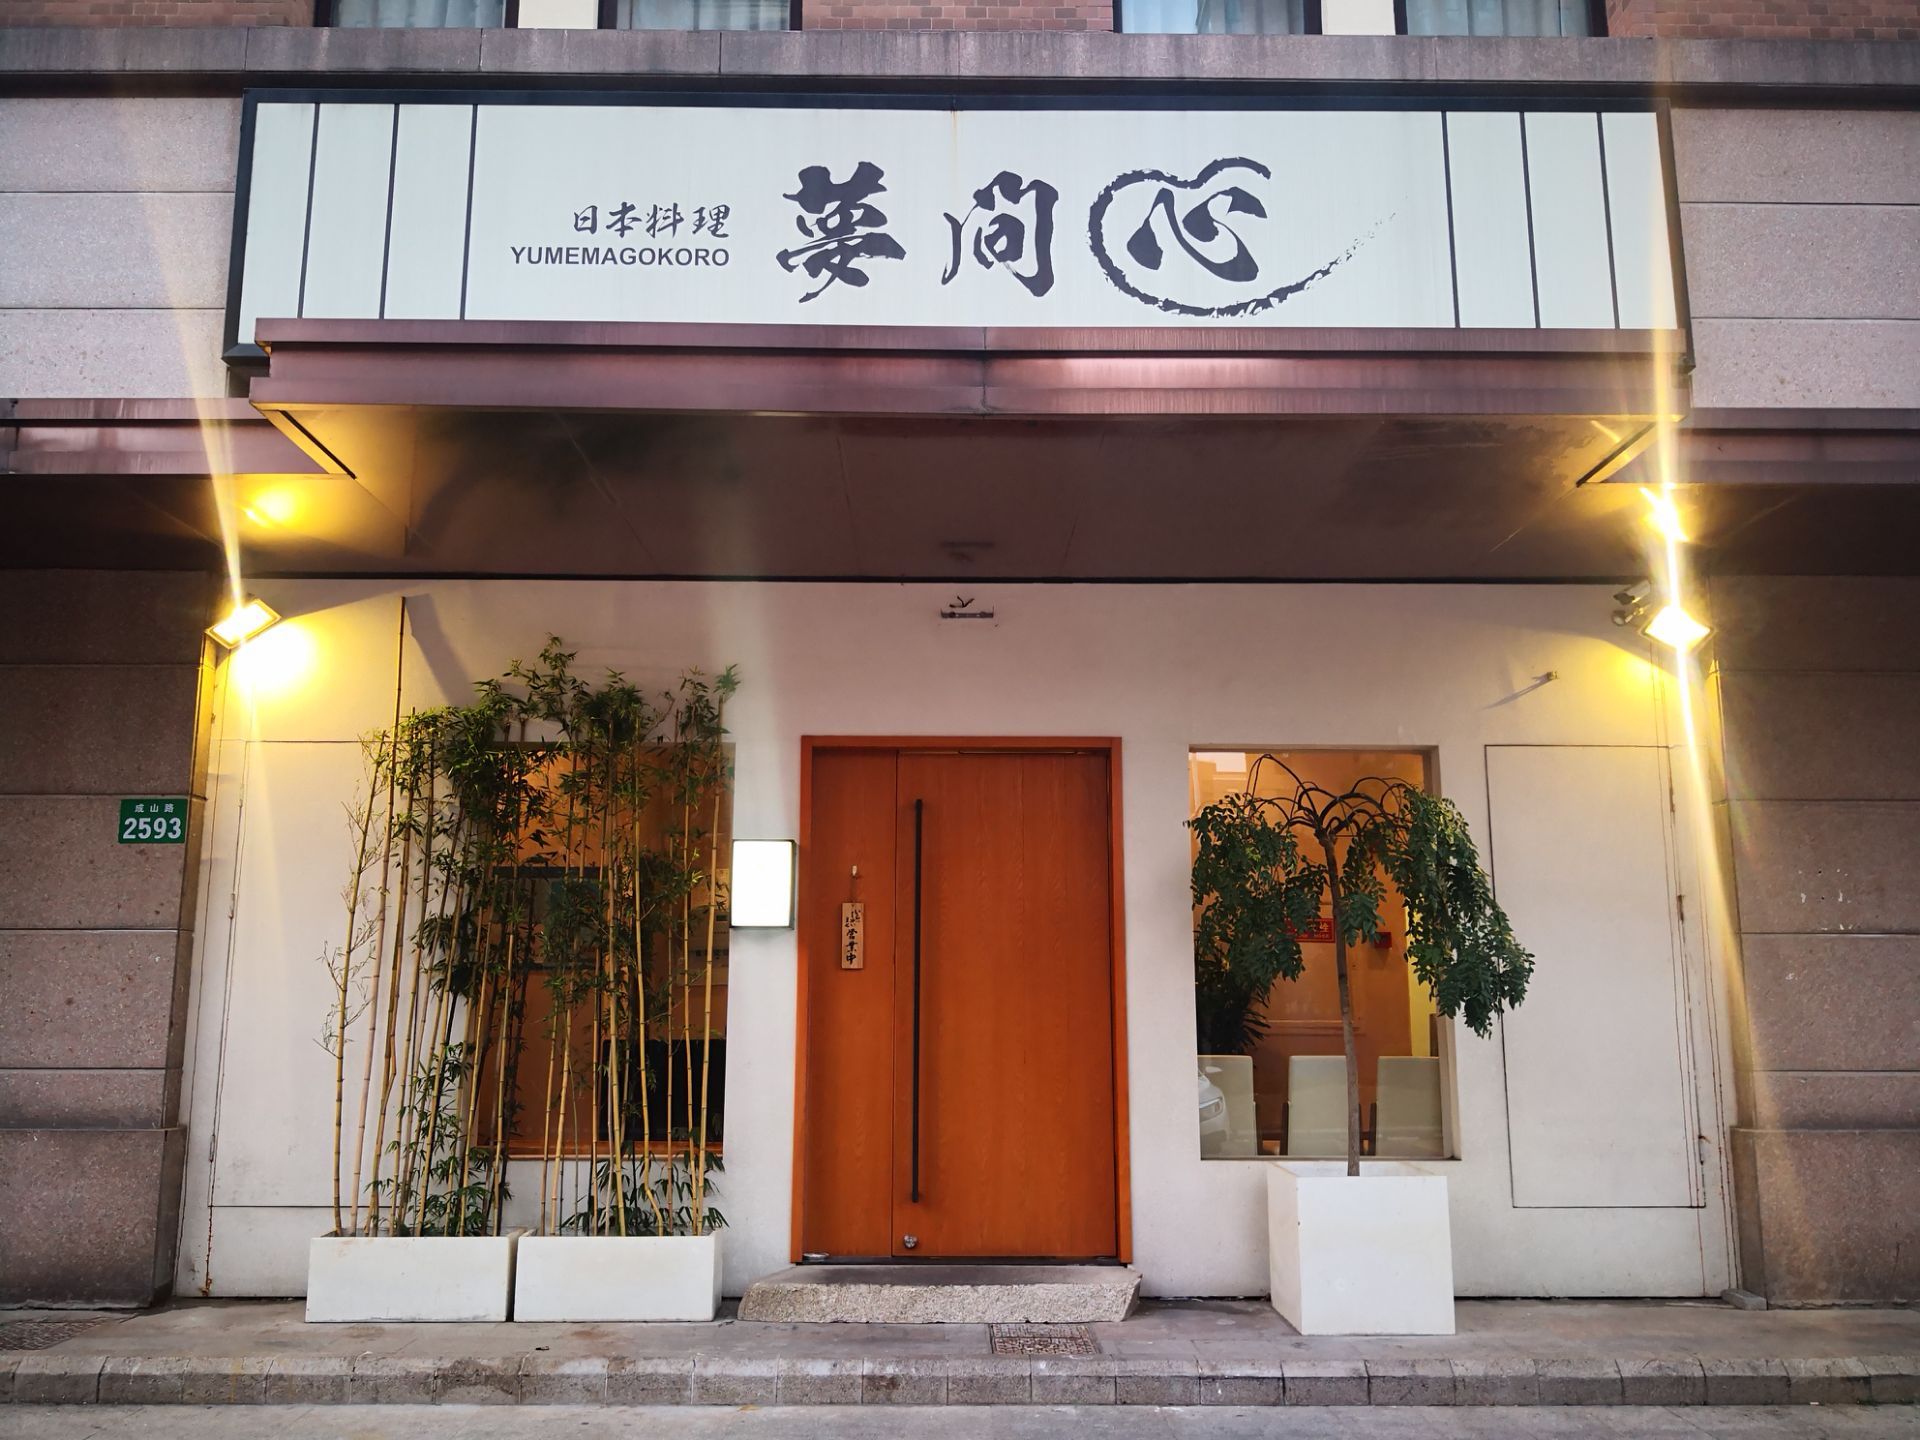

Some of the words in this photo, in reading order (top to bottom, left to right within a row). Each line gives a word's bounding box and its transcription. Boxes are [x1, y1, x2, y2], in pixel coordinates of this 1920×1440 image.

[574, 201, 730, 238] 日本料理
[510, 246, 730, 267] YUMEMAGOKORO
[122, 817, 182, 839] 2593
